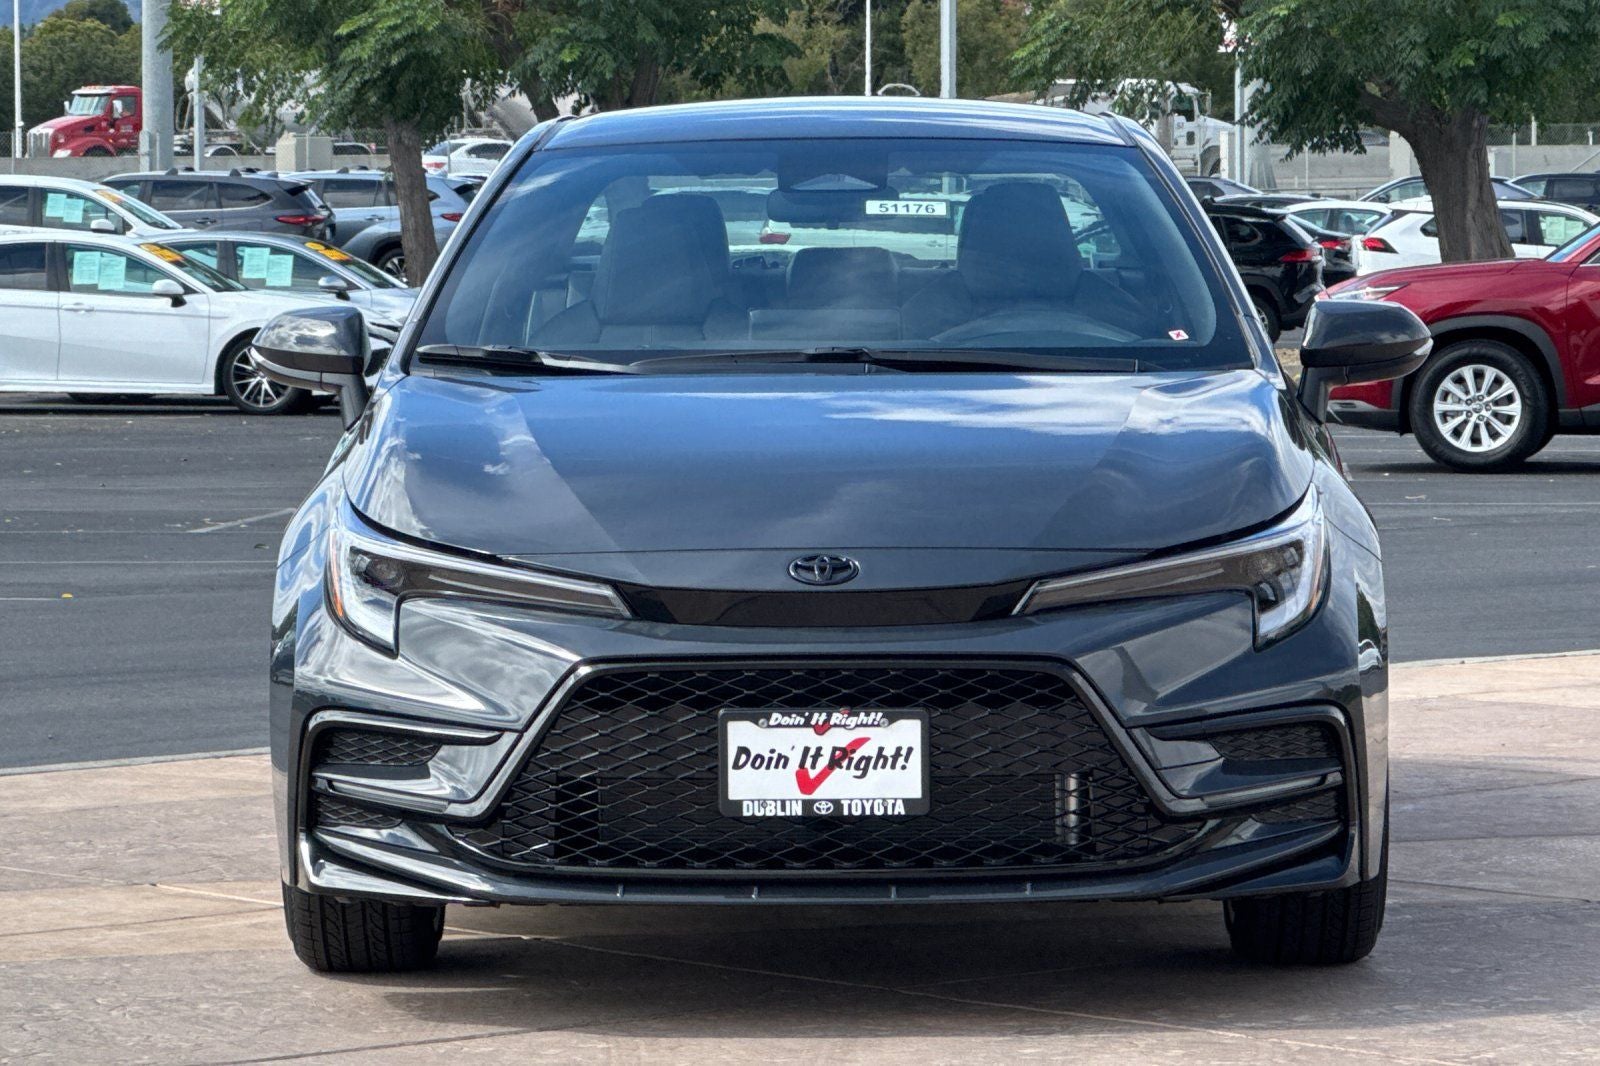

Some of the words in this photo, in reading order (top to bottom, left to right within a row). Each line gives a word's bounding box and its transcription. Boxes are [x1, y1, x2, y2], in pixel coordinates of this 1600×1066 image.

[879, 203, 936, 214] 51176
[769, 712, 809, 726] Doin'
[811, 712, 829, 726] It
[829, 712, 883, 730] Right!
[731, 745, 795, 771] Doin'
[800, 746, 823, 770] It
[827, 745, 914, 779] Right!
[742, 800, 803, 816] DUBLIN
[840, 799, 906, 816] TOYOTA
